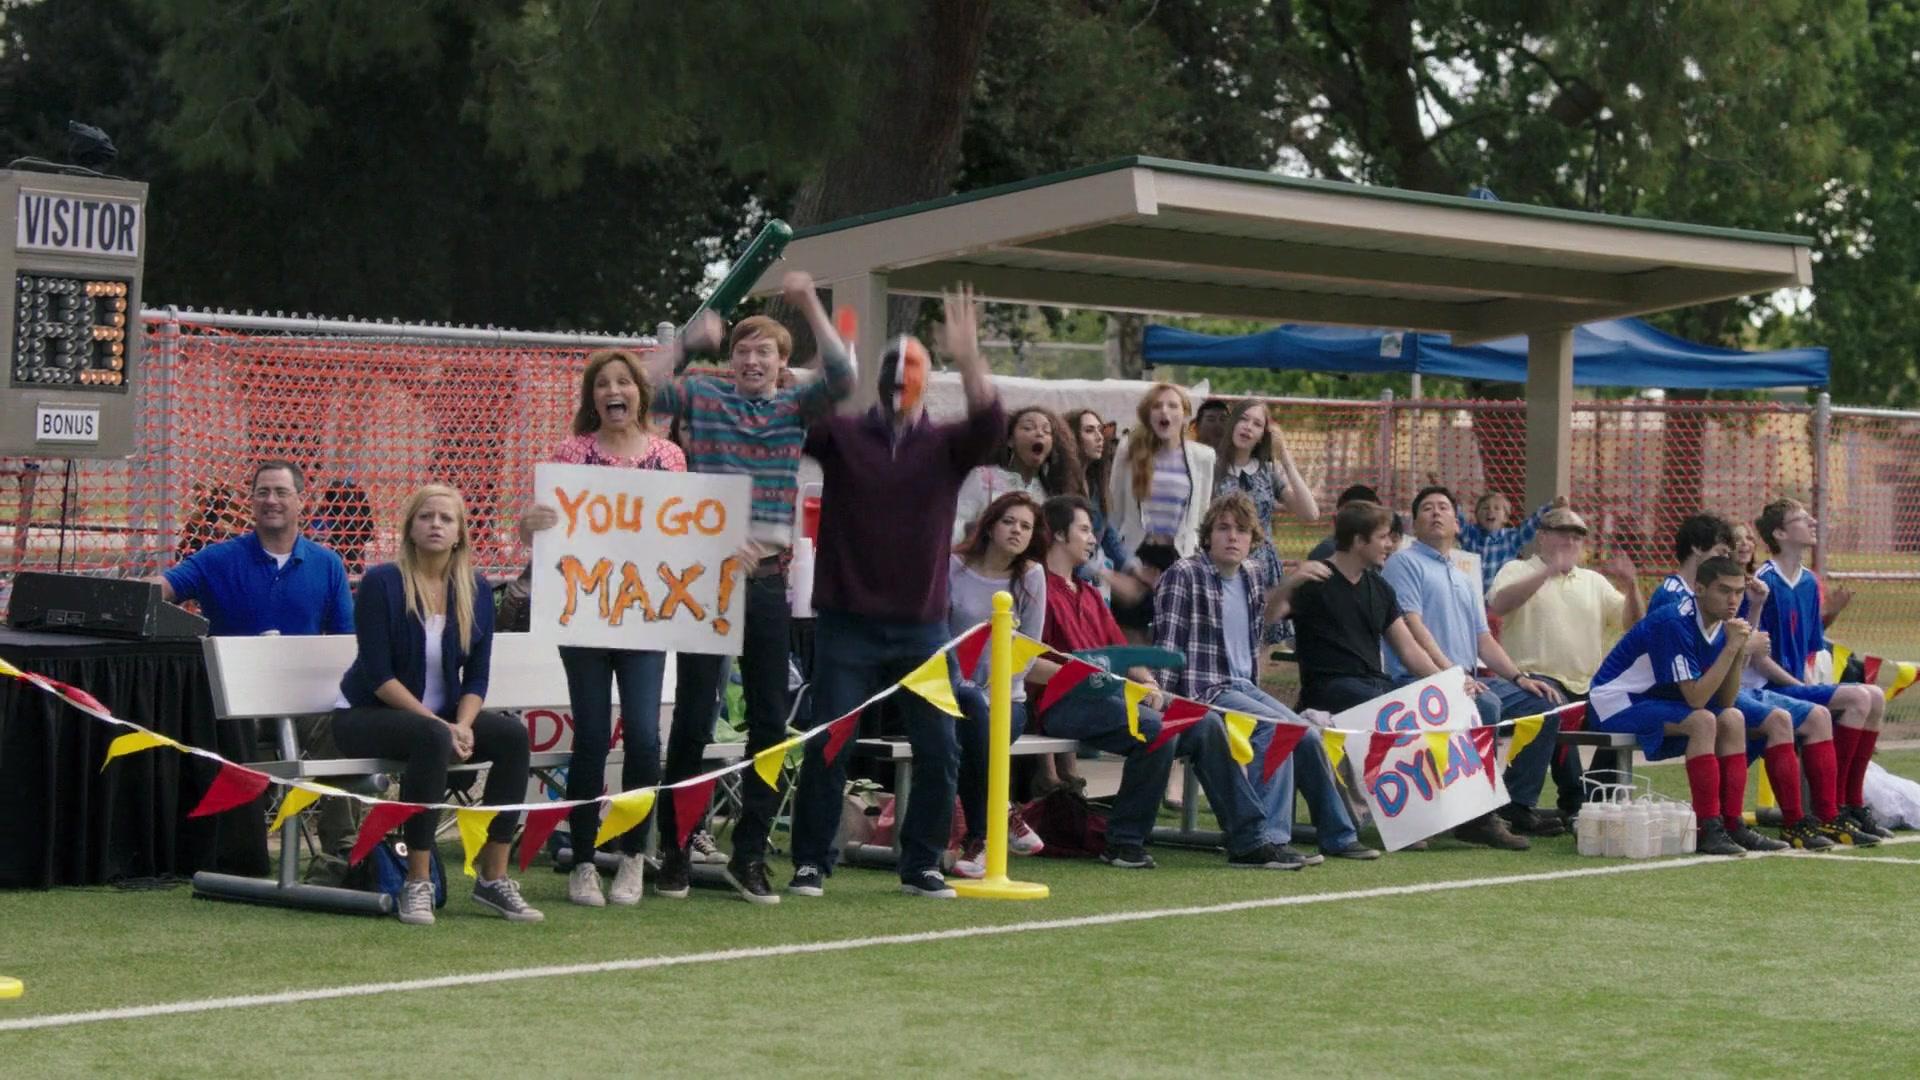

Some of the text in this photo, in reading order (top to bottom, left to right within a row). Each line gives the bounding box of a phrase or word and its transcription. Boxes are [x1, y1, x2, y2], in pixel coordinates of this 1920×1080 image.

[25, 196, 136, 252] VISITOR
[80, 281, 127, 386] 3
[43, 413, 94, 435] BONUS
[555, 486, 726, 538] YOU GO
[556, 555, 741, 636] MAX!
[1376, 685, 1449, 747] GO
